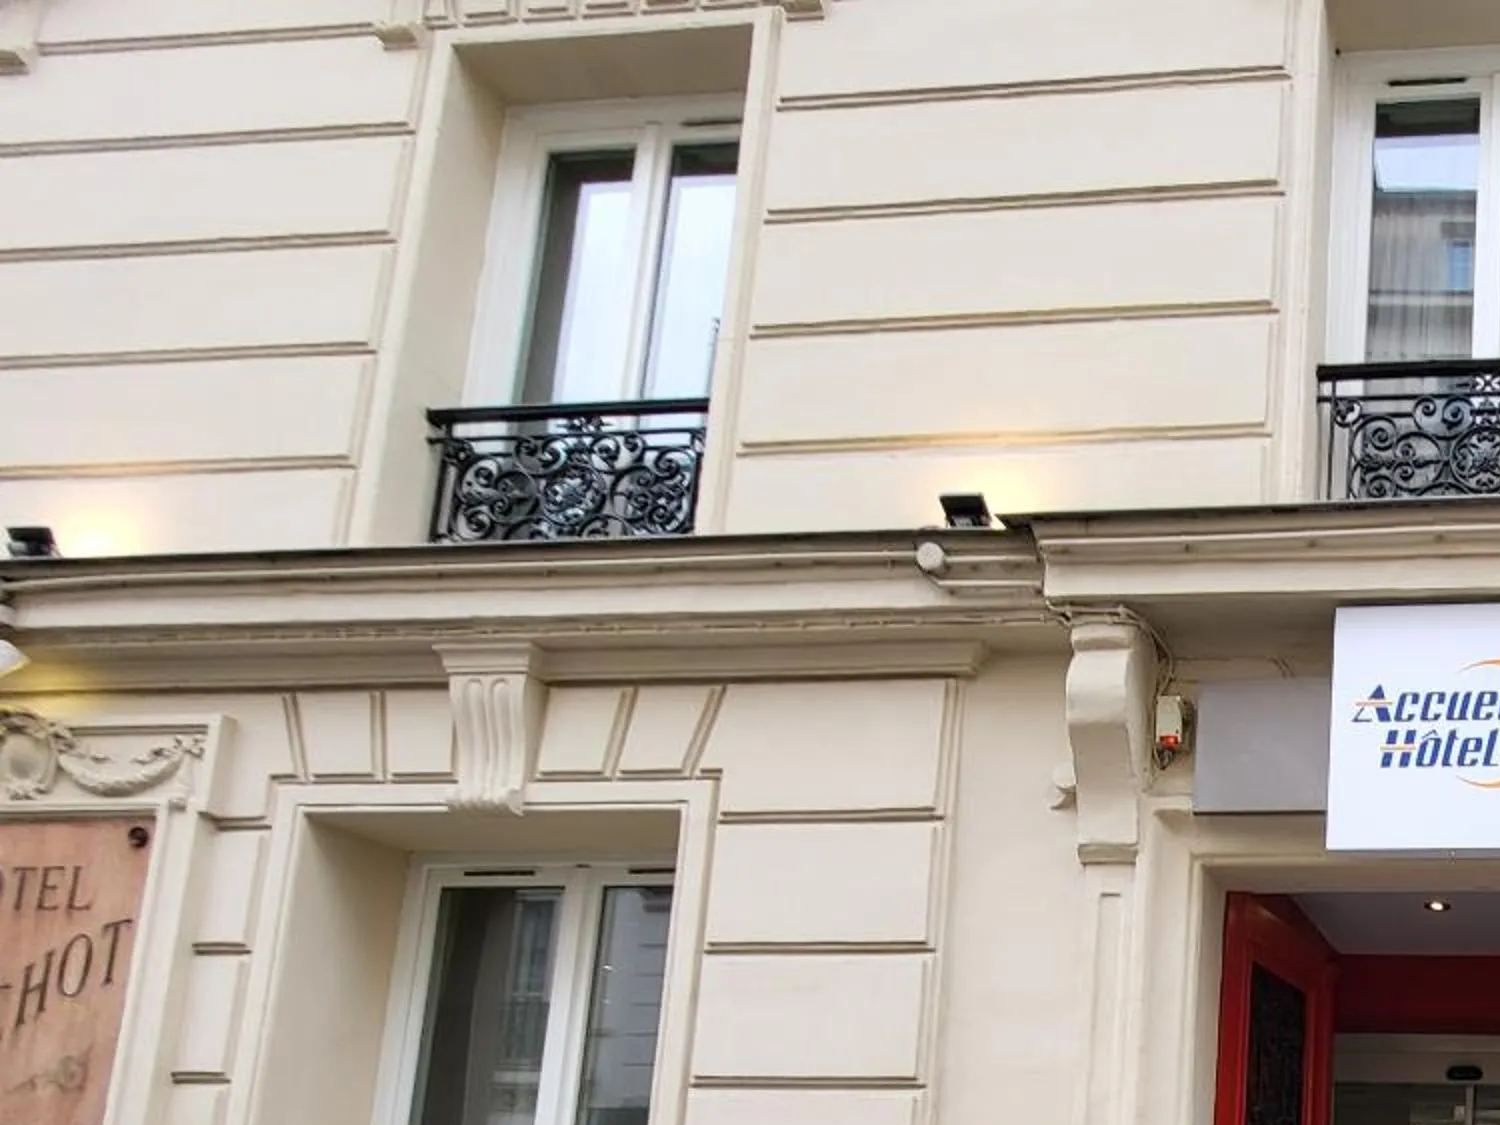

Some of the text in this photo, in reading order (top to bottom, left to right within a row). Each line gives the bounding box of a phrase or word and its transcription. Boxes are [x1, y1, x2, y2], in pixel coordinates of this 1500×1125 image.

[1380, 728, 1499, 768] Hôtel
[0, 866, 94, 913] TEL
[0, 918, 134, 1040] HOT
